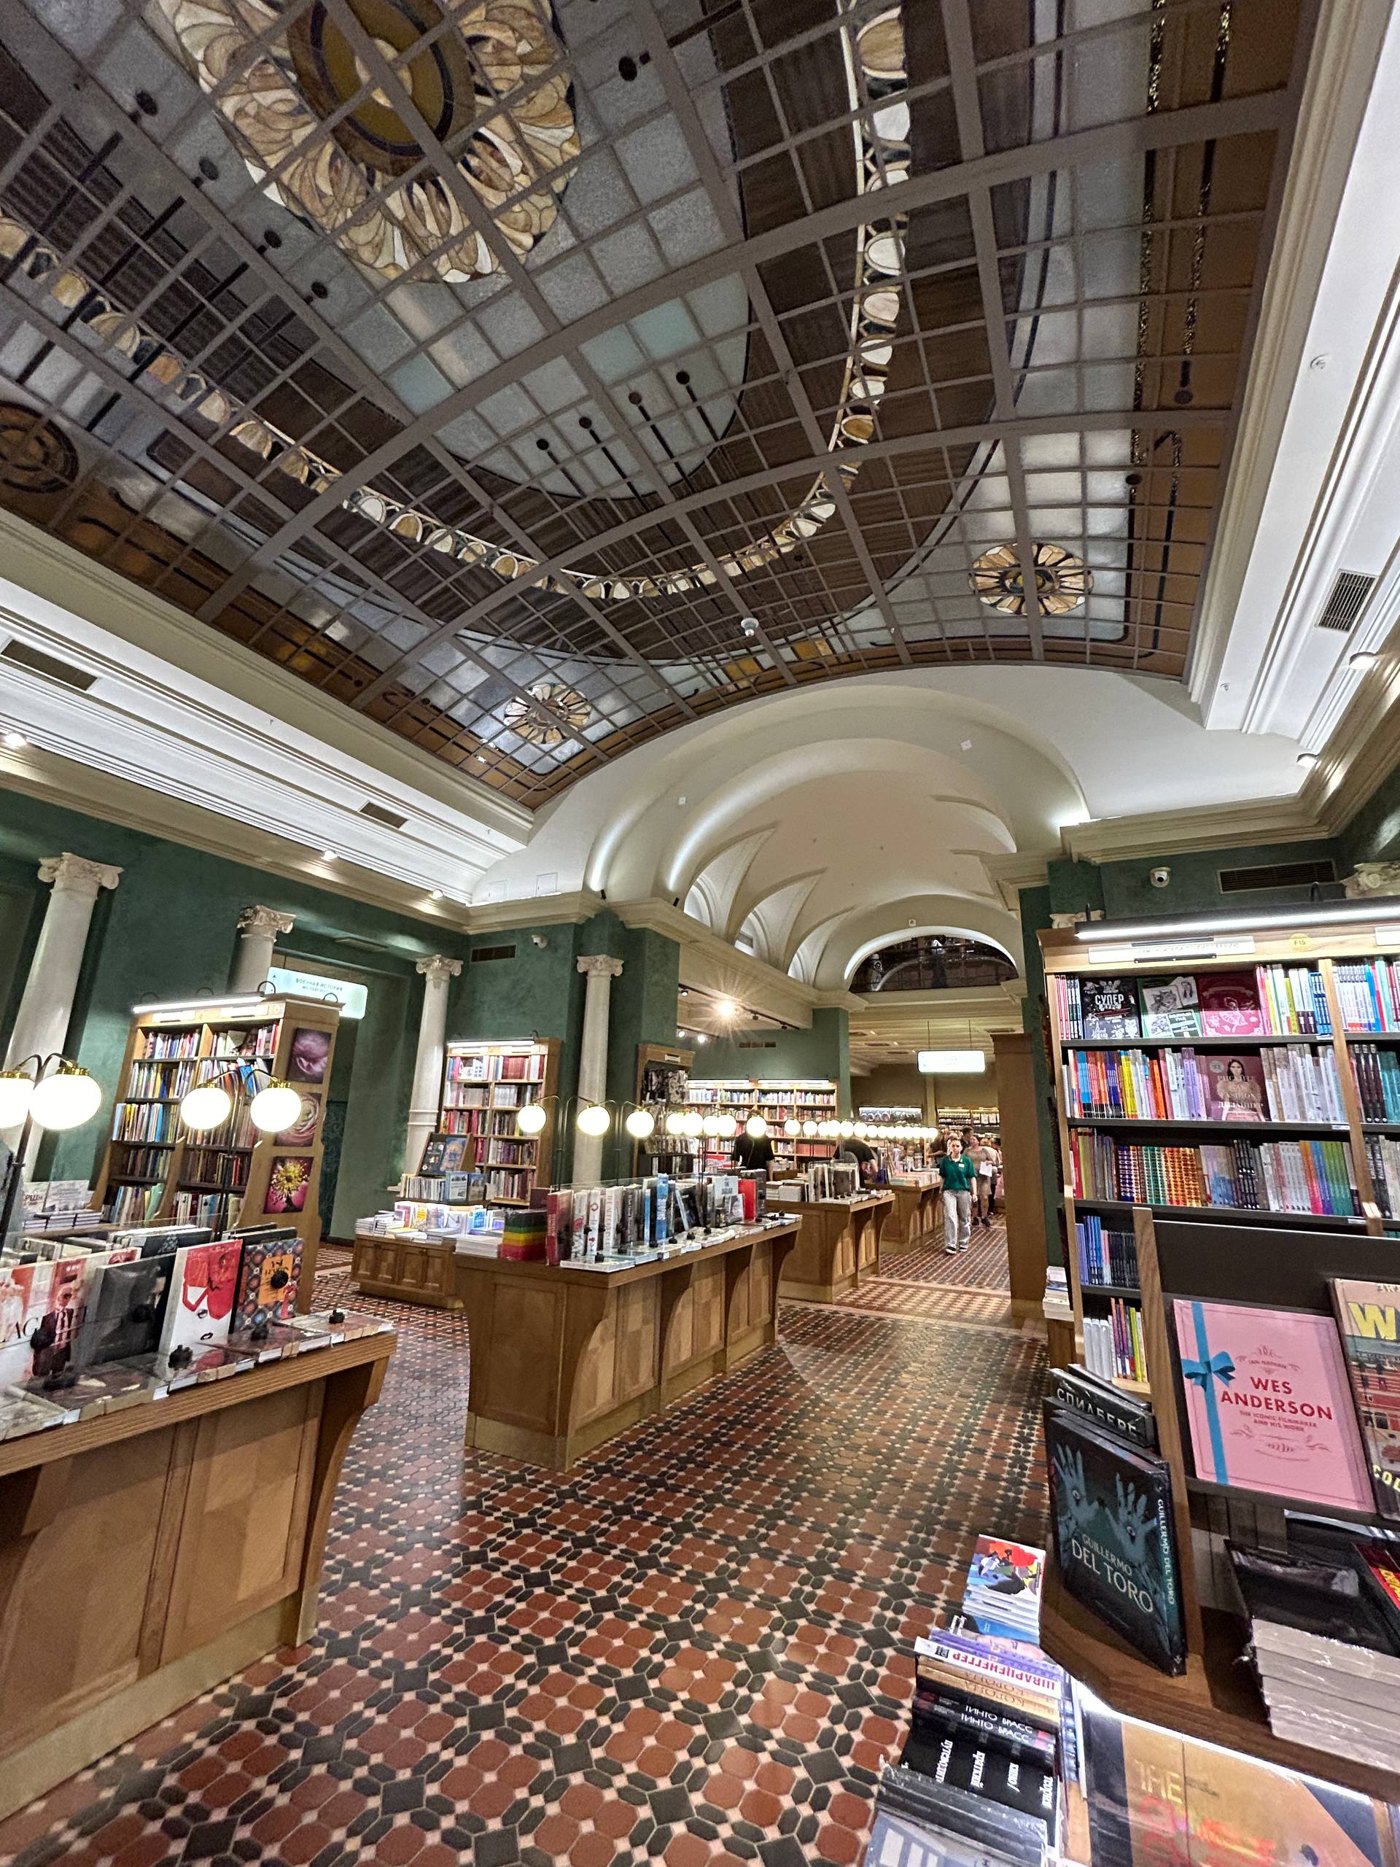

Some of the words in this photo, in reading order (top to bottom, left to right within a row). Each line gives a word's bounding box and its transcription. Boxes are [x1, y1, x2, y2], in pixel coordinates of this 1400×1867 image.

[1094, 993, 1124, 1005] СУПЕР
[1250, 1376, 1292, 1394] WES
[1221, 1390, 1333, 1420] ANDERSON
[1157, 1499, 1170, 1555] GUILLERMO
[1082, 1533, 1133, 1577] GUILLERMO
[1164, 1557, 1173, 1576] DEL
[1071, 1538, 1101, 1575] DEL
[1104, 1562, 1154, 1613] TORO
[1166, 1578, 1175, 1605] TORO
[952, 1652, 1055, 1690] ШВАРЦЕНЕГГЕР
[961, 1713, 994, 1730] ТИНТО
[998, 1726, 1030, 1743] БРАСС
[965, 1705, 998, 1721] ТИНТО
[1002, 1718, 1034, 1734] БРАСС
[970, 1750, 985, 1789] краткий
[1134, 1759, 1184, 1804] THE
